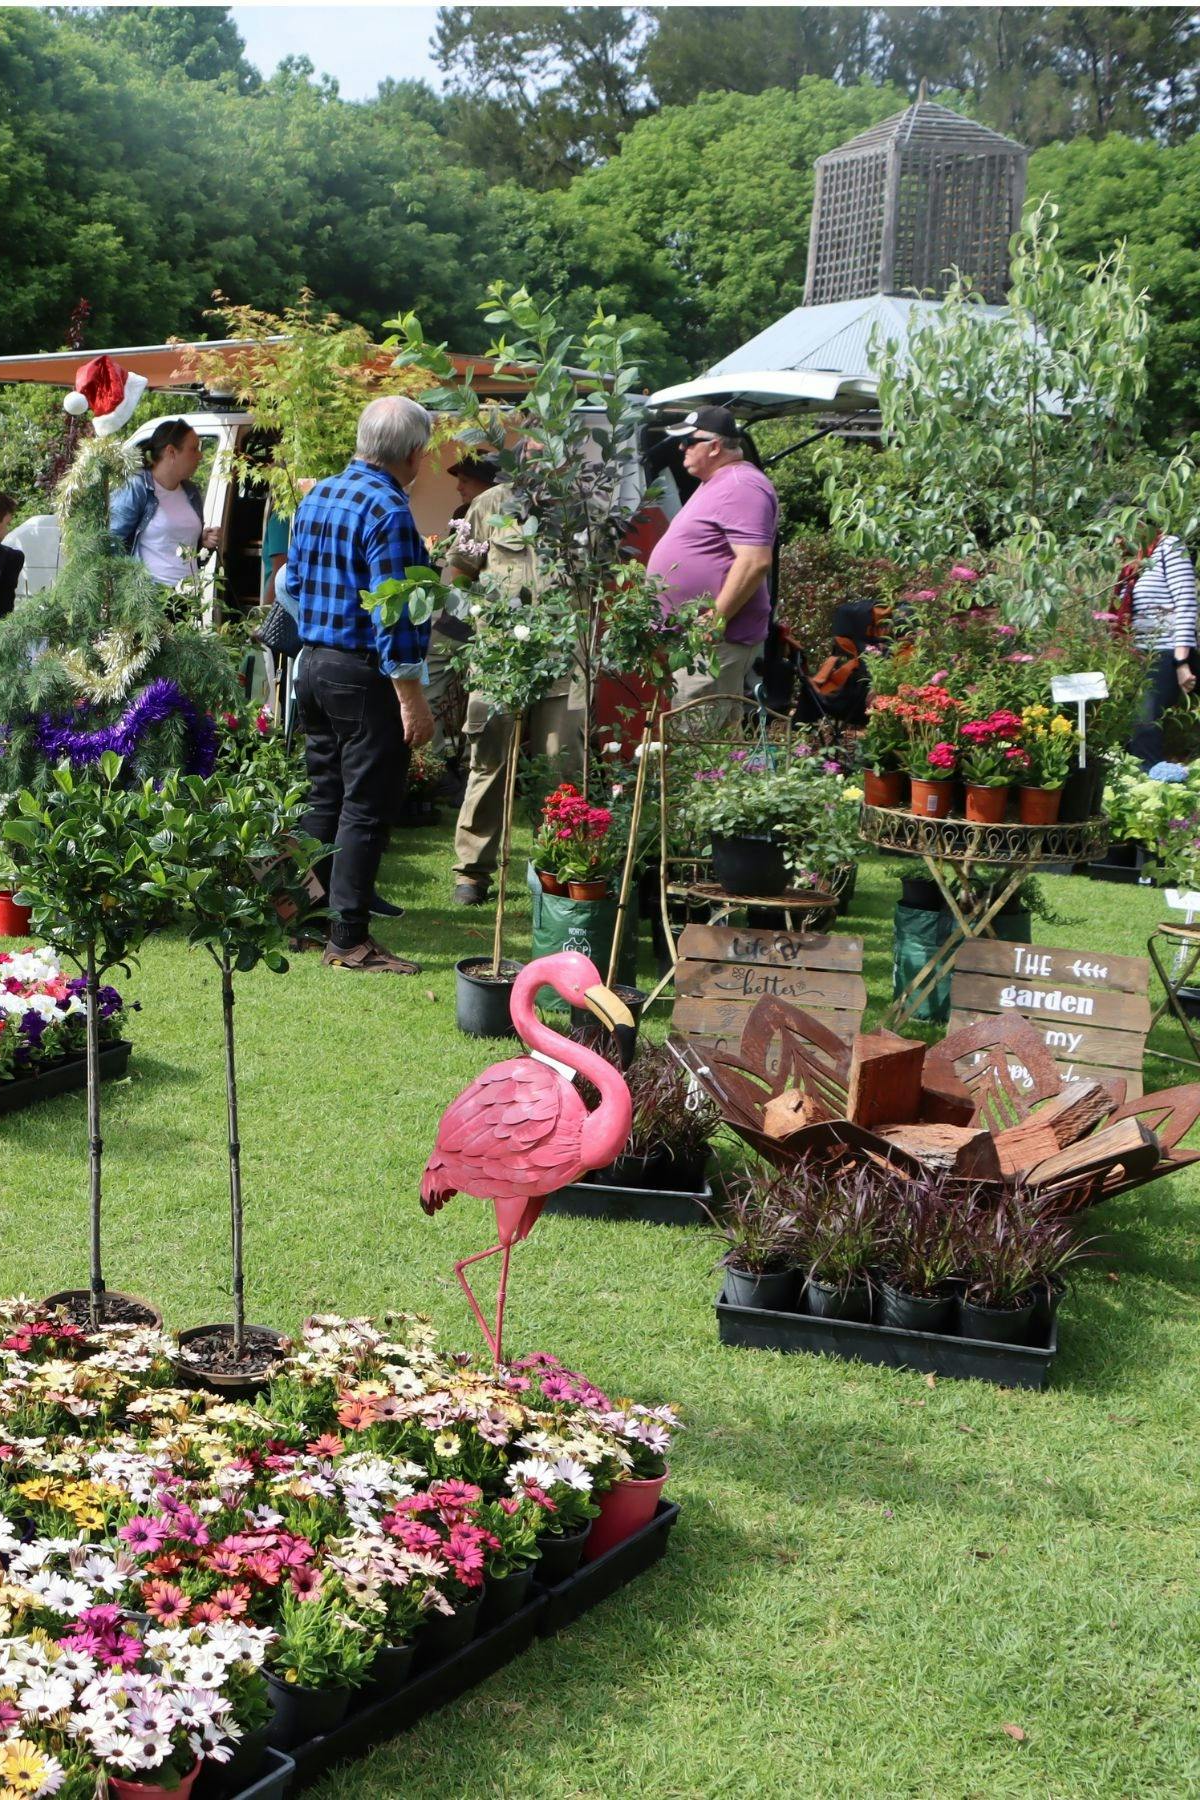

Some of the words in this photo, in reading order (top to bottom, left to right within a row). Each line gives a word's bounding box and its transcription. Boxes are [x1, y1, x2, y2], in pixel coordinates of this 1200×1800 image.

[568, 927, 587, 937] NORTH
[1014, 947, 1052, 977] THE
[999, 985, 1094, 1016] garden
[1045, 1030, 1084, 1053] my
